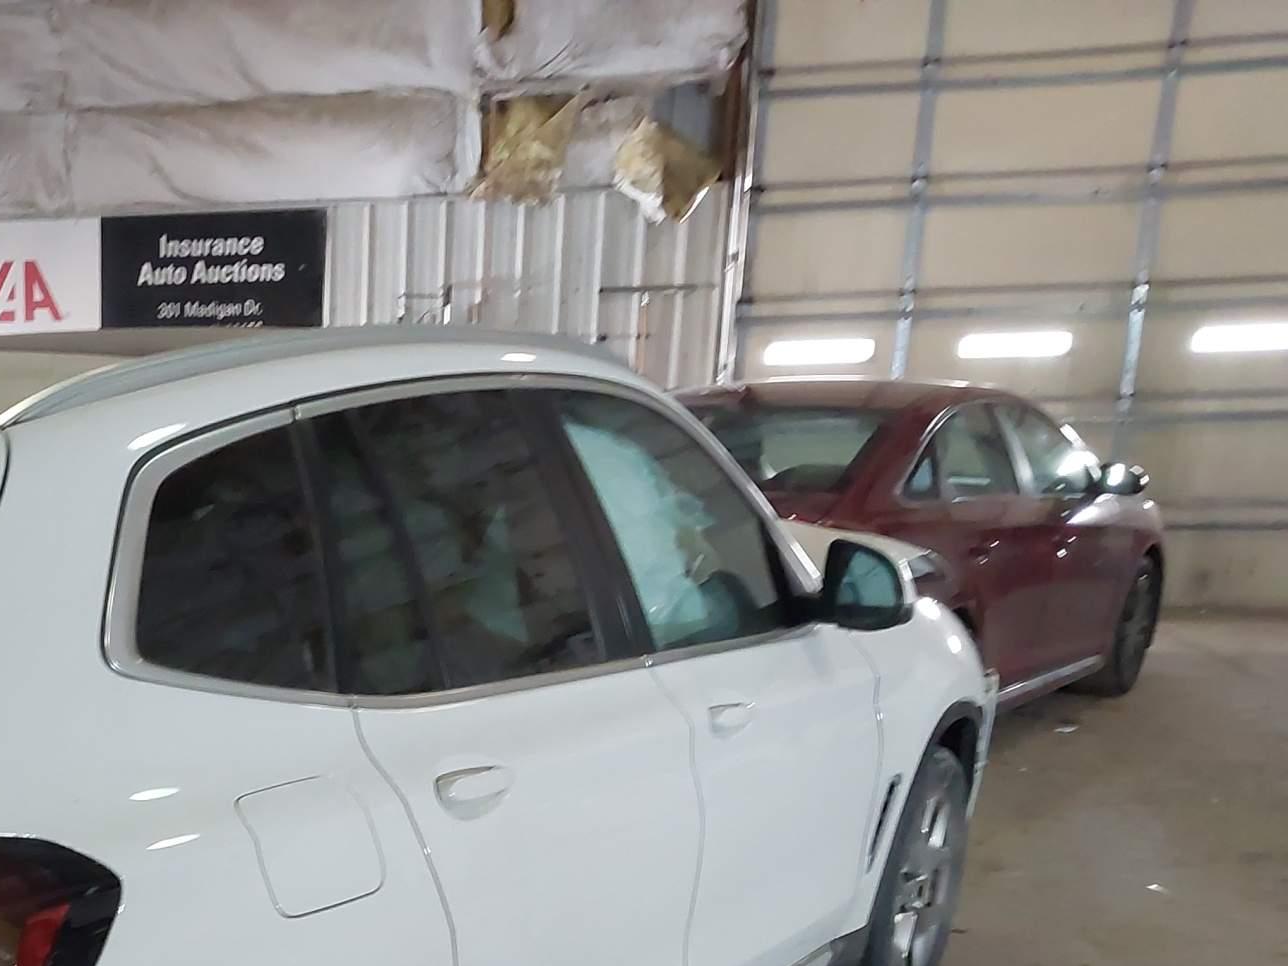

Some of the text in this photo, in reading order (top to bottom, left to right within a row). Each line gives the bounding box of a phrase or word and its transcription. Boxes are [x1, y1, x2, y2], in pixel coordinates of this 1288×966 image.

[159, 233, 265, 258] Insurance
[137, 258, 286, 287] Auto Auctions
